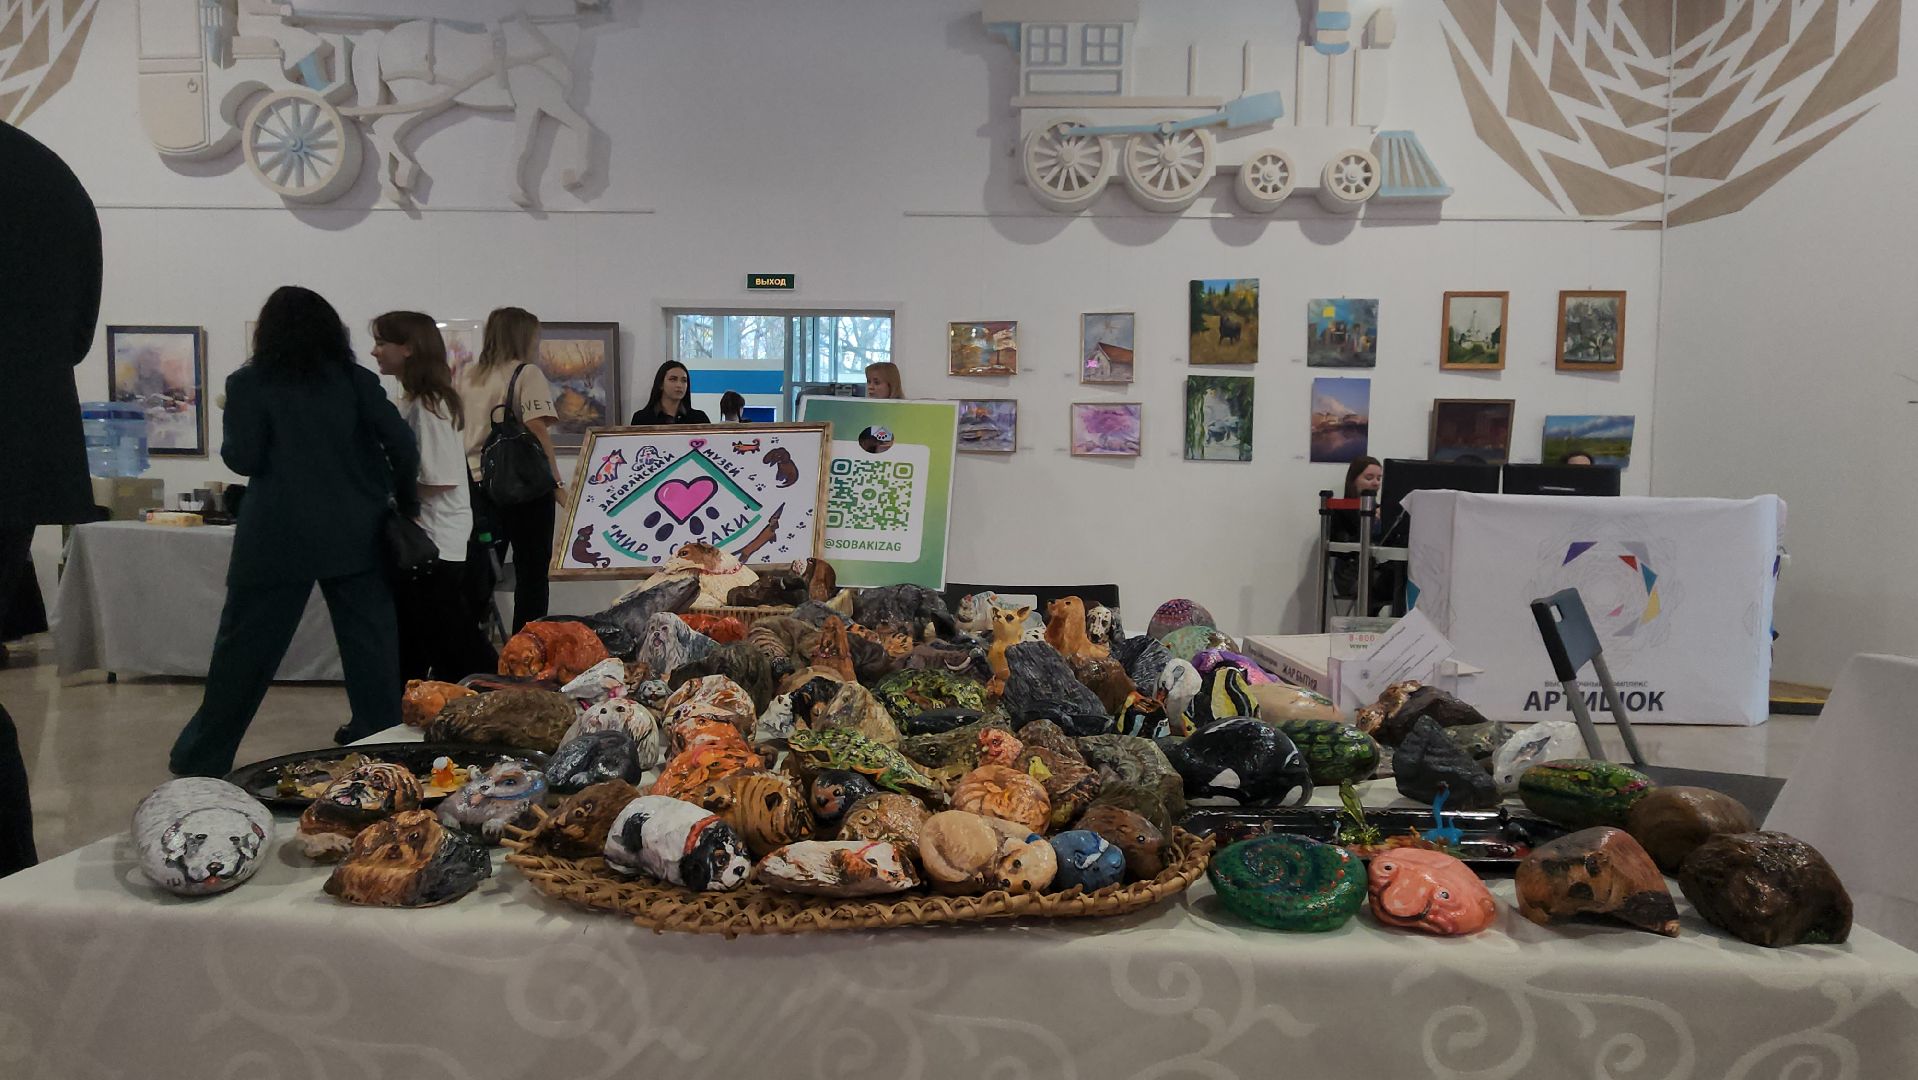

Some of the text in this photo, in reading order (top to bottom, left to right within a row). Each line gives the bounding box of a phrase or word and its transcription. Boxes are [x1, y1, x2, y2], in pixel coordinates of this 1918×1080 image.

[755, 278, 787, 286] ВЫХОД
[598, 448, 745, 512] ЗАГОРЯНСКИЙ МУЗЕЙ
[669, 504, 750, 556] СБАКИ"
[824, 538, 902, 552] @SOBAKIZAG
